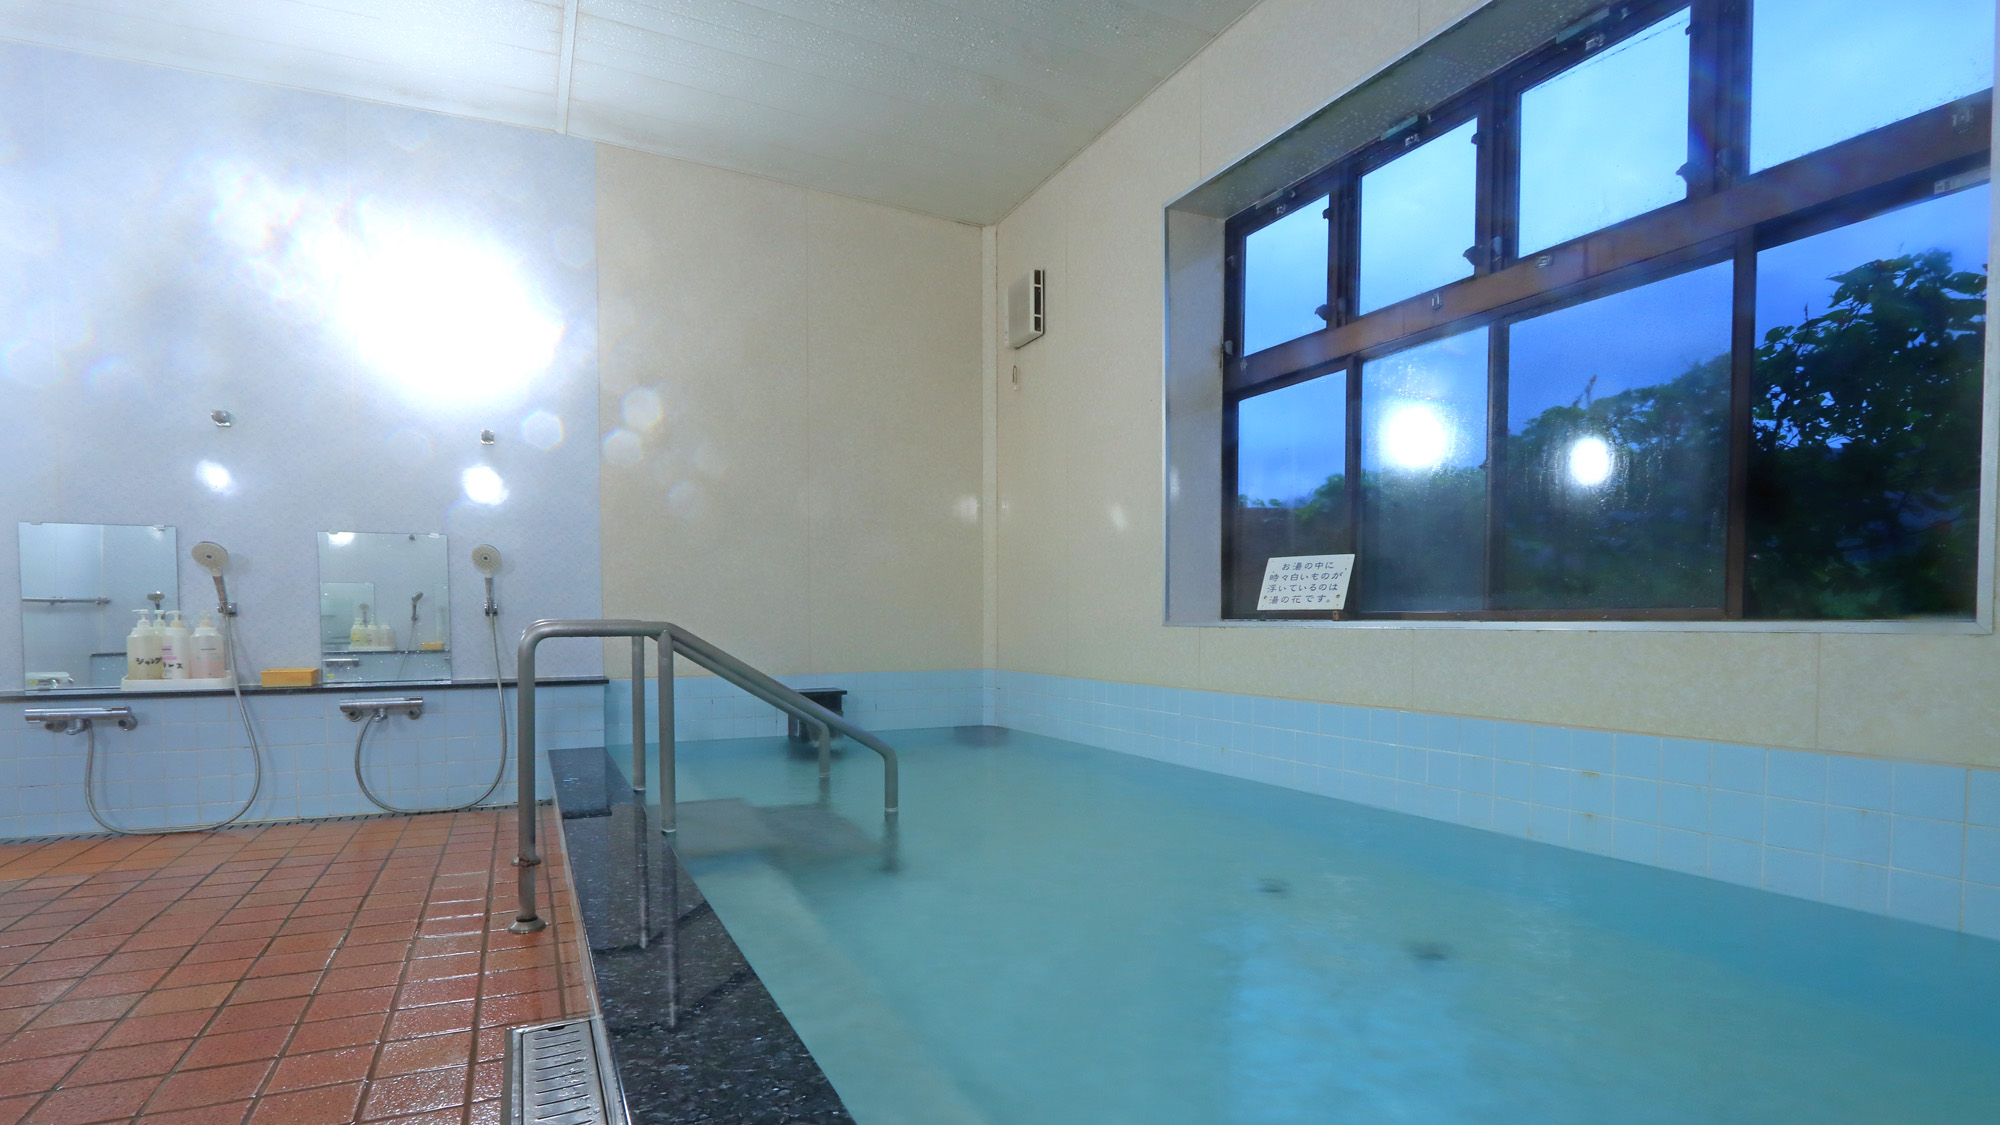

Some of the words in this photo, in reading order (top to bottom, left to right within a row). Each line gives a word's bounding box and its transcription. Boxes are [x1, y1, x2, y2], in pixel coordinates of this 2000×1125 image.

[1281, 562, 1334, 571] お湯の中に
[1269, 572, 1344, 582] 時々白いものが
[1267, 584, 1338, 593] 浮いているのは
